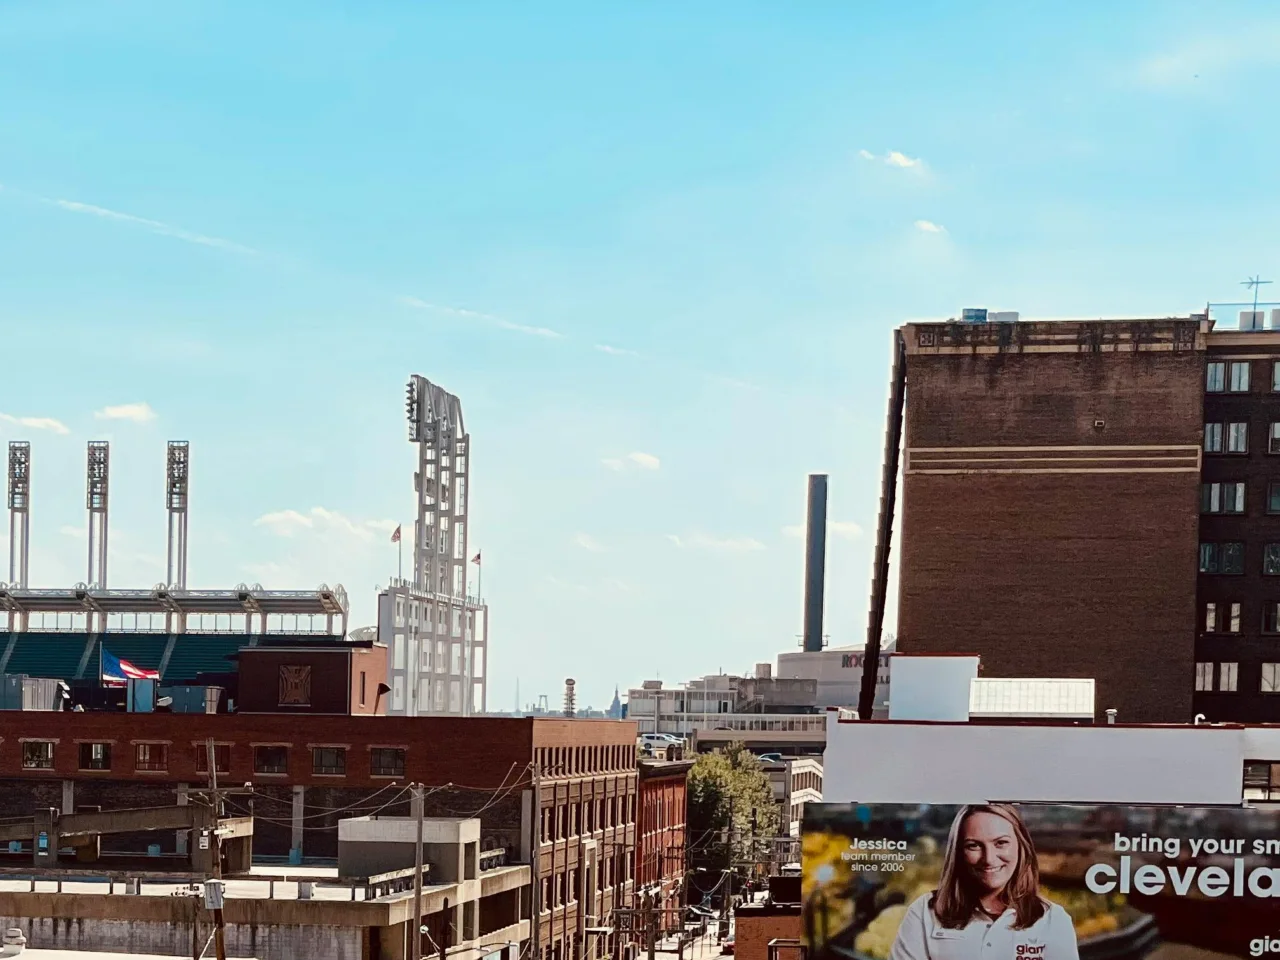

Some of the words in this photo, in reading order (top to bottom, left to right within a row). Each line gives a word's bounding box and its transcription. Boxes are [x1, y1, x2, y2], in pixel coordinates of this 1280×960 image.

[849, 837, 907, 850] Jessica
[1114, 832, 1180, 858] bring
[1189, 838, 1245, 858] your
[841, 851, 868, 861] team
[870, 852, 916, 861] member
[851, 863, 878, 872] since
[880, 863, 905, 872] 2006
[1085, 855, 1280, 898] clevela
